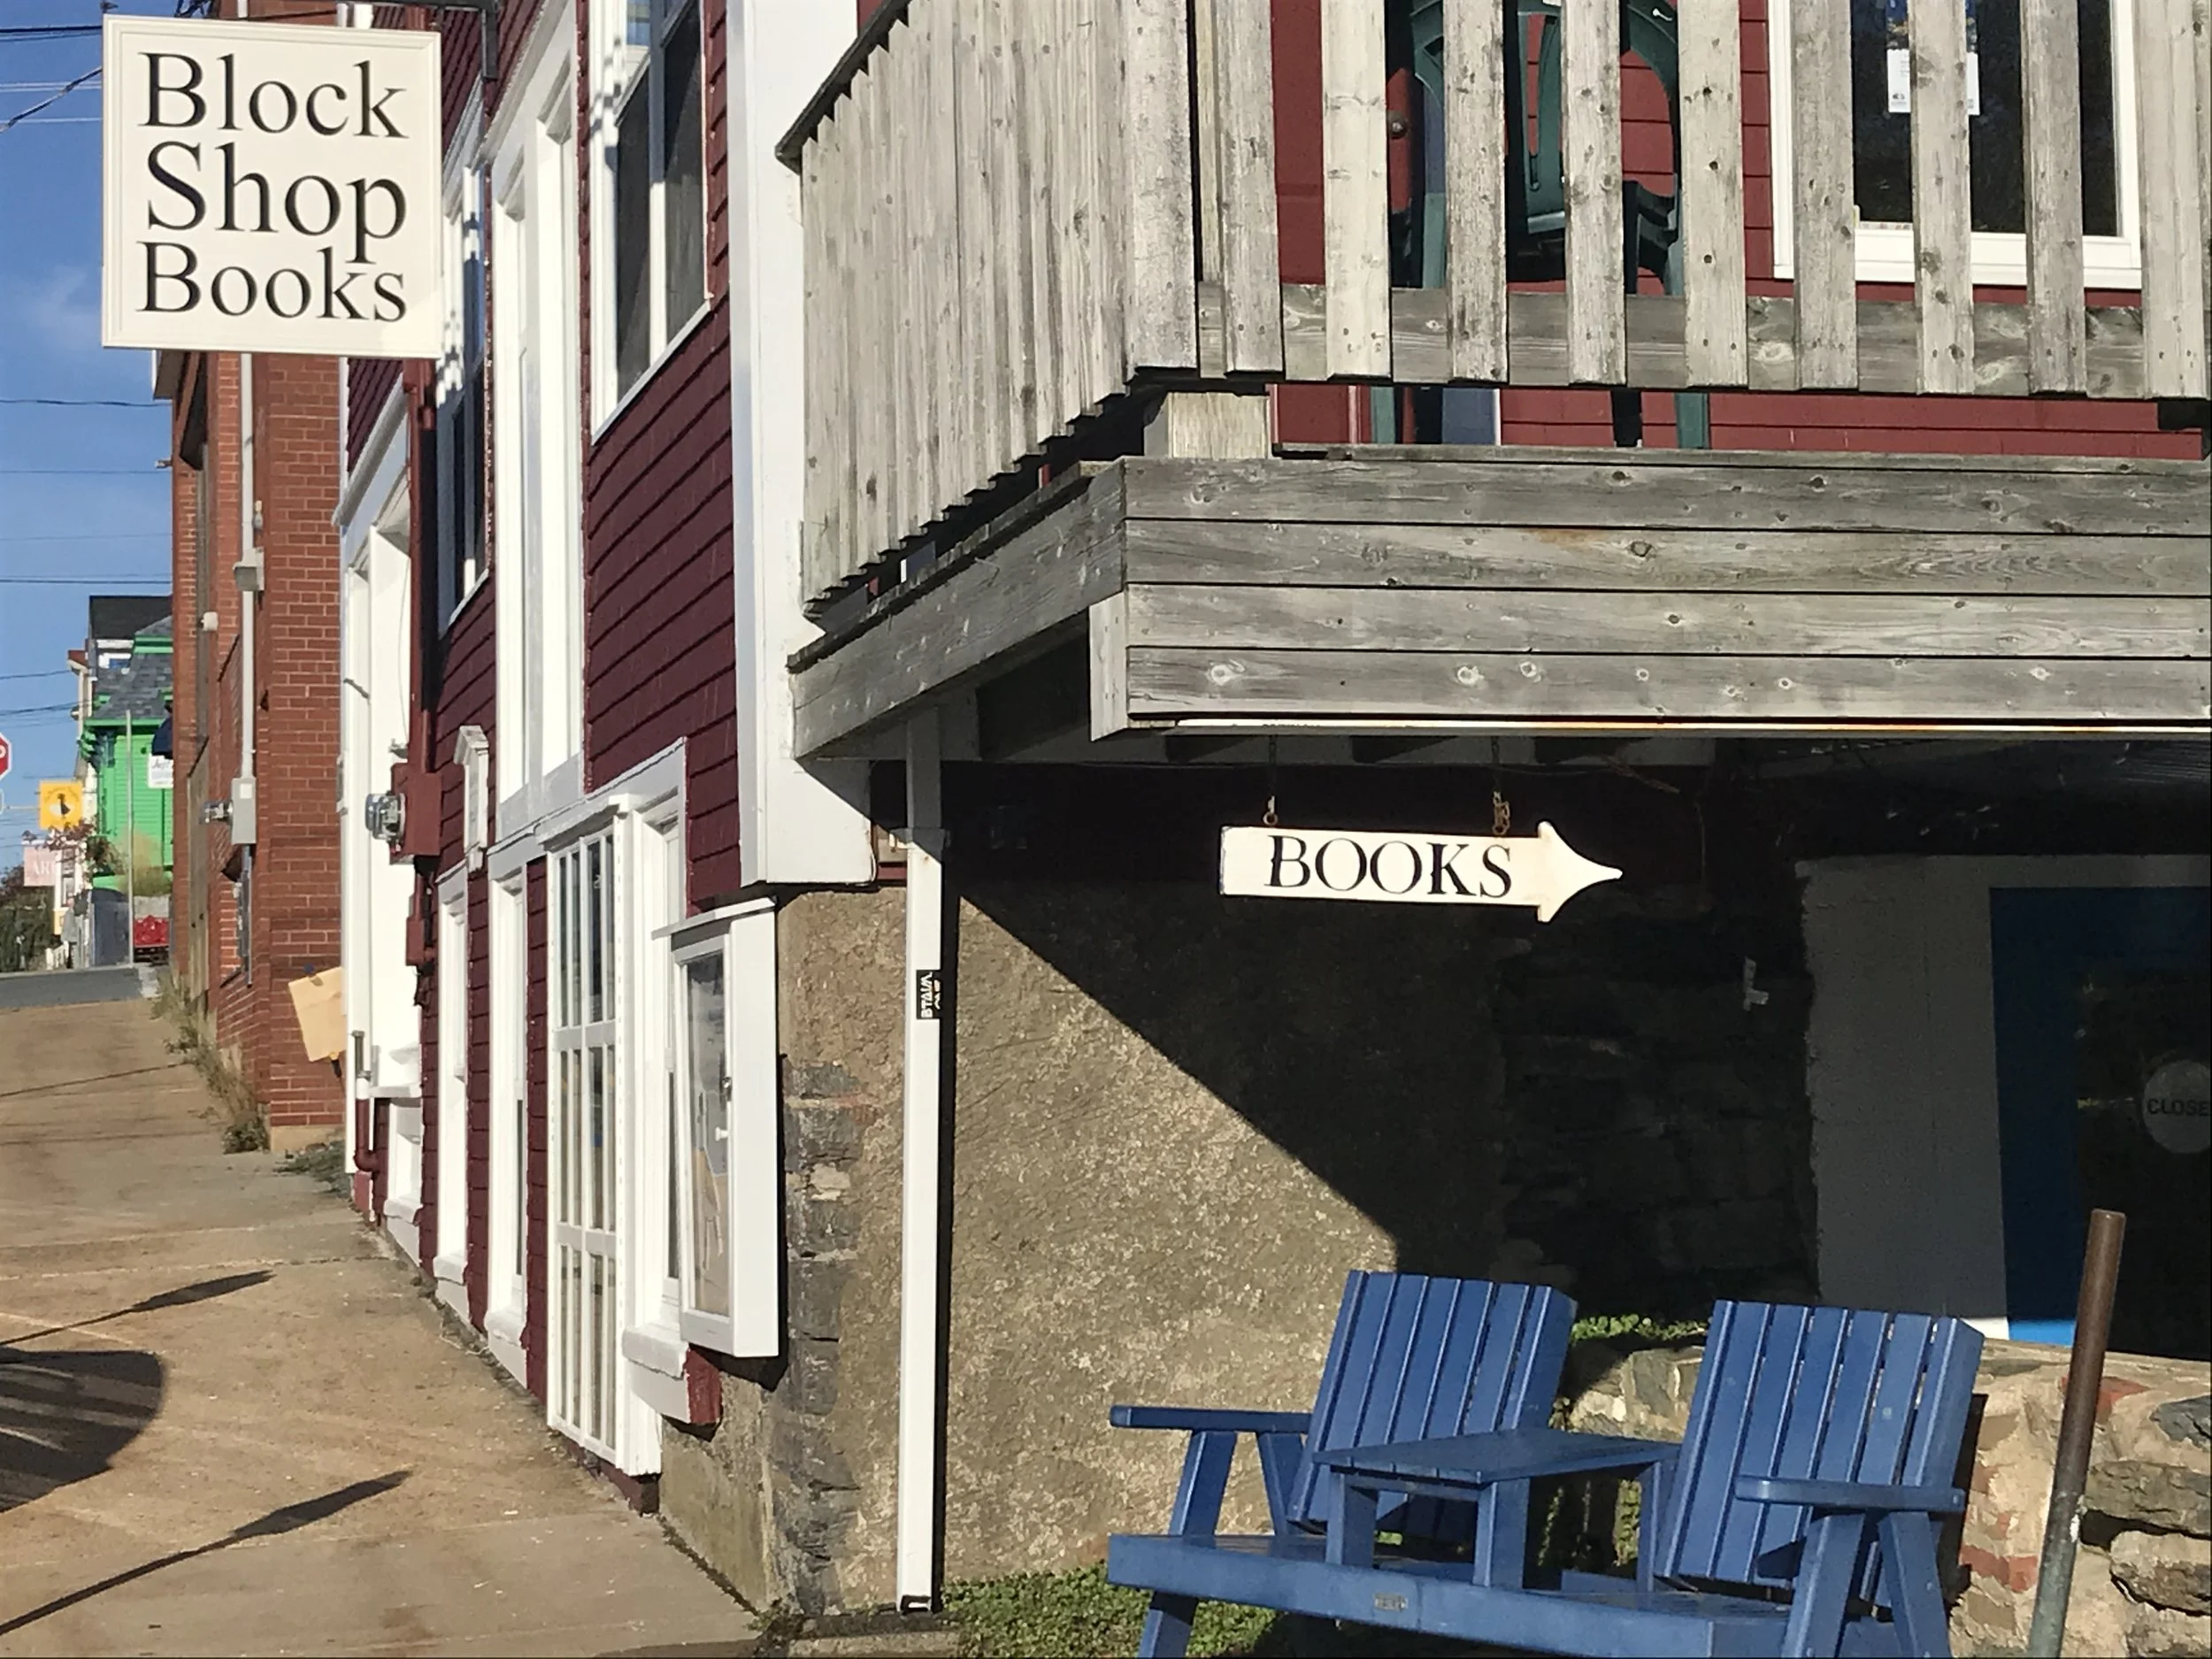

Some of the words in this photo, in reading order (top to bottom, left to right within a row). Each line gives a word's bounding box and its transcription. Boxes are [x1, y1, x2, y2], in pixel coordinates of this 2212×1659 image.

[138, 52, 409, 138] Block
[147, 141, 407, 264] Shop
[136, 242, 407, 322] Books
[1263, 834, 1513, 898] BOOKS
